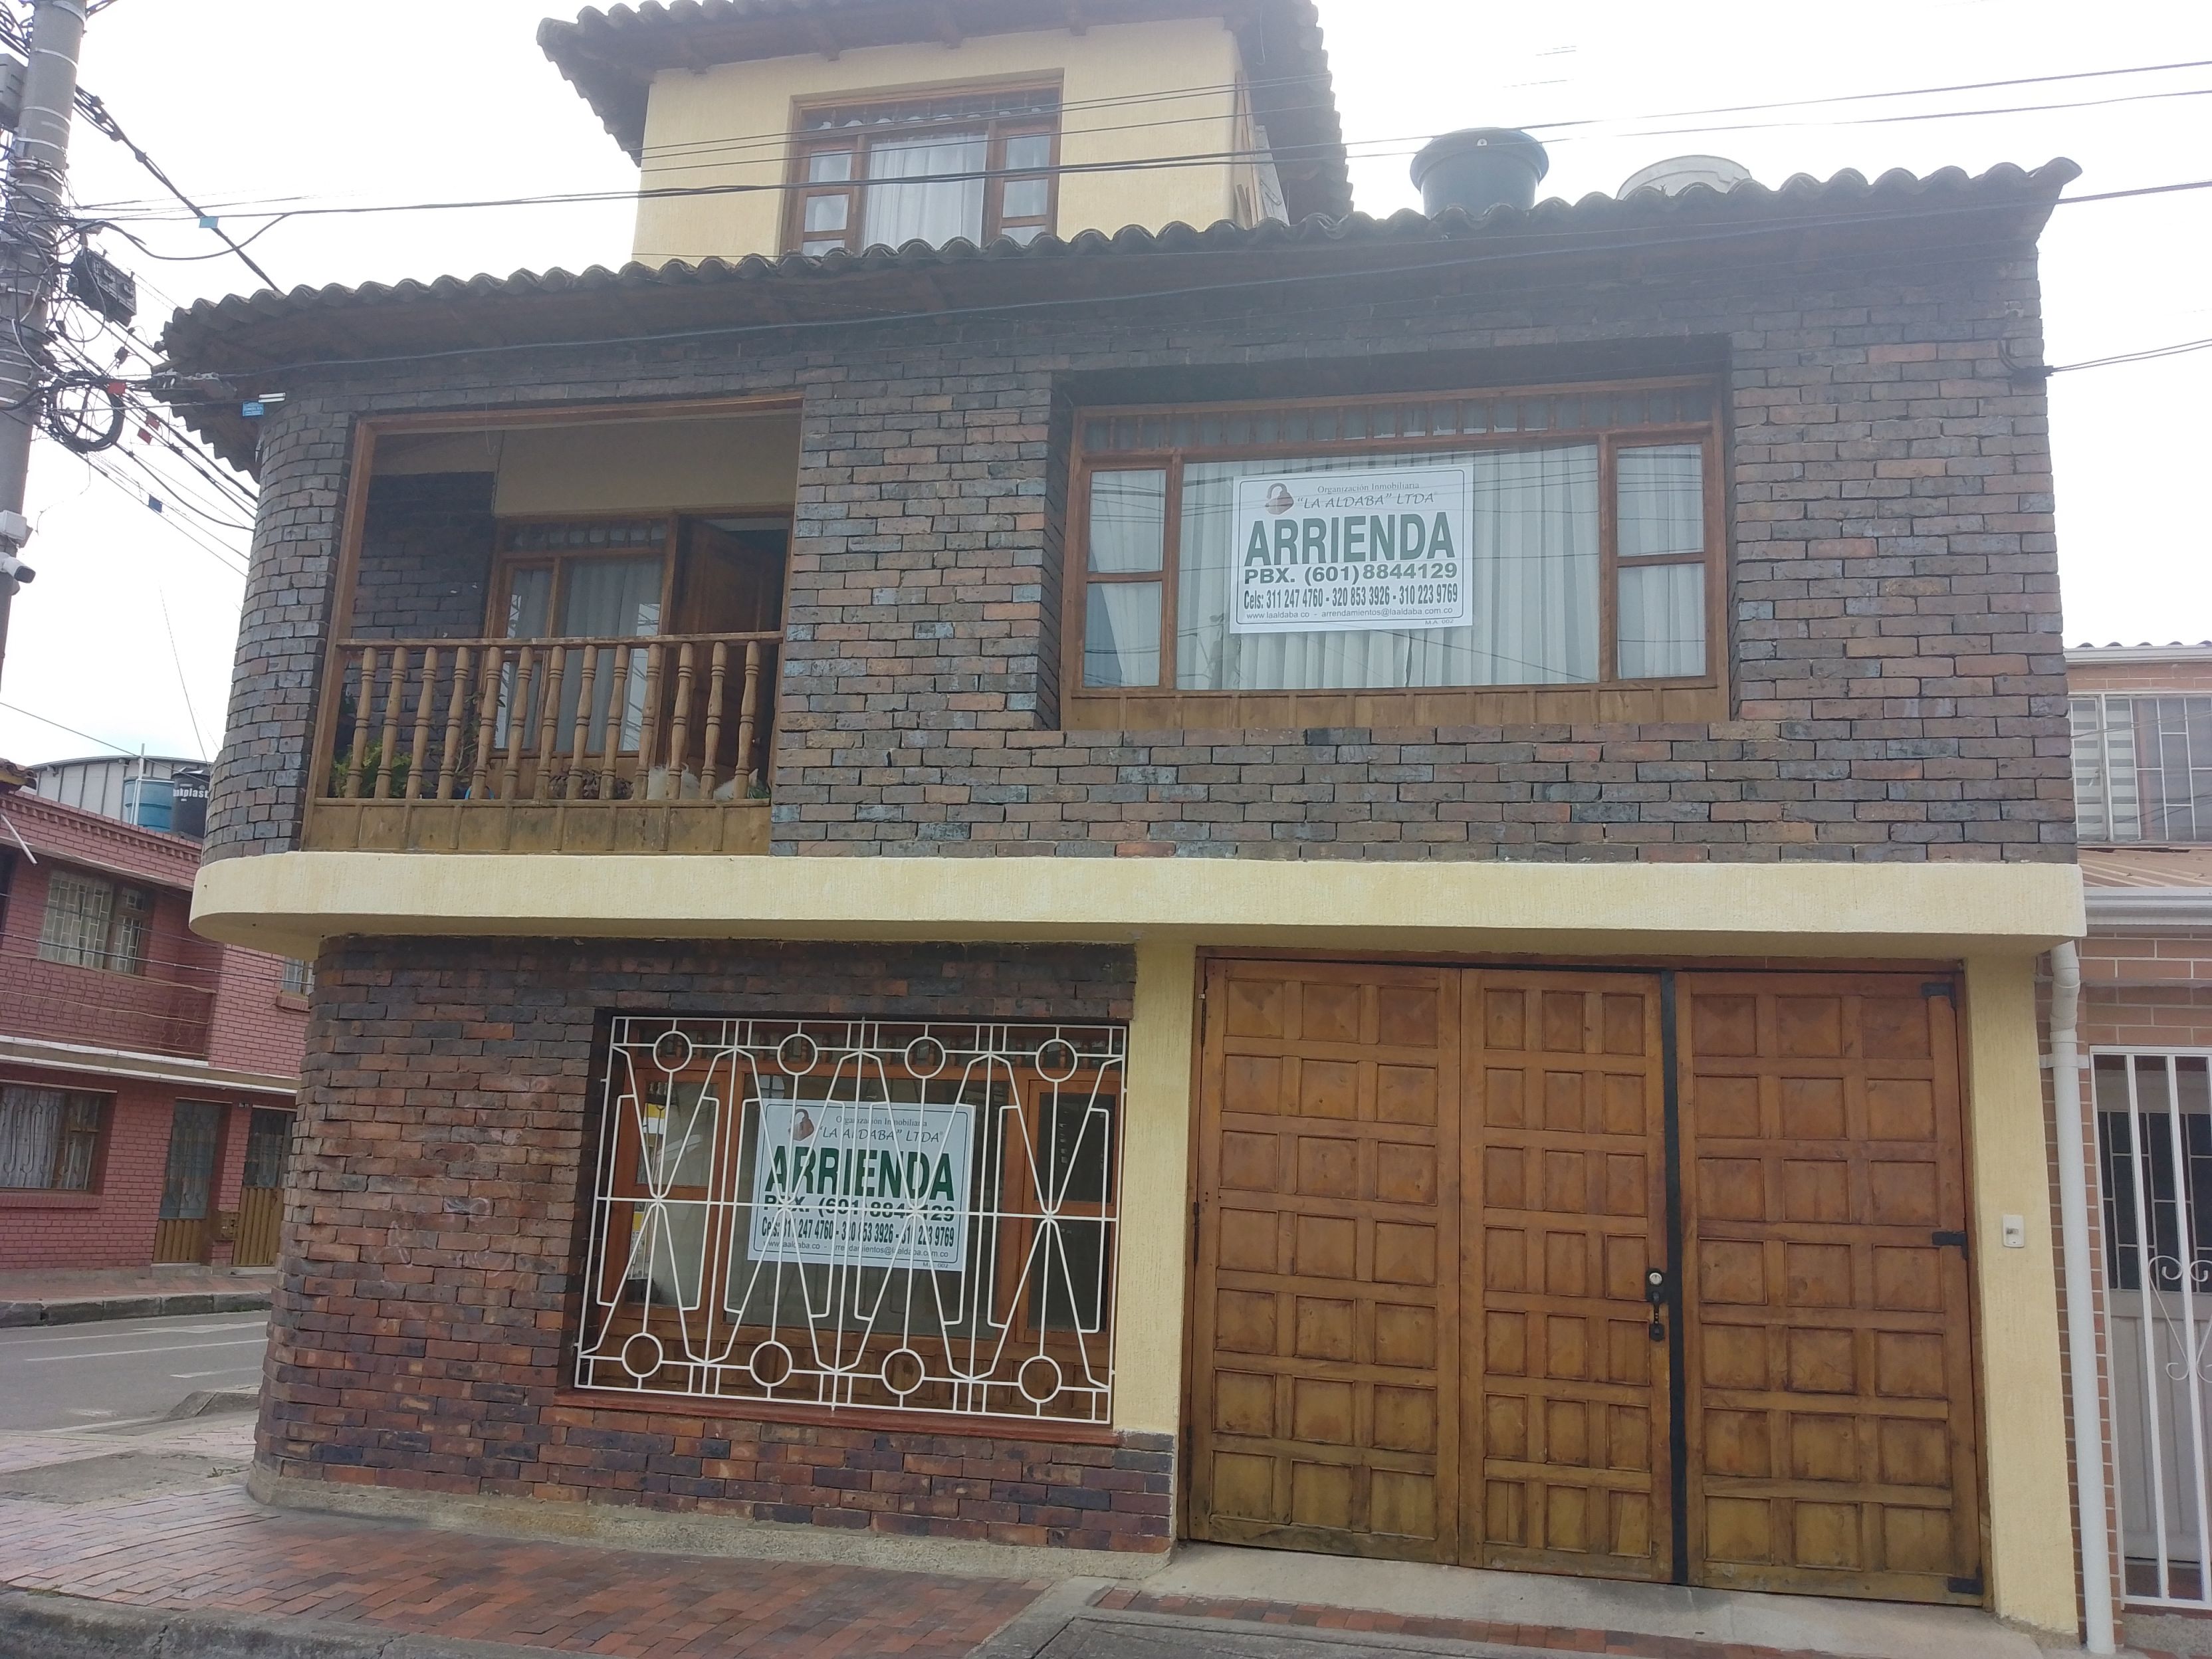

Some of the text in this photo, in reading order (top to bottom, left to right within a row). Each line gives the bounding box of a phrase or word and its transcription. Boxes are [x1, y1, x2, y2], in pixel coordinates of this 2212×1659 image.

[1317, 482, 1420, 495] Organización Inmobiliaria
[1396, 493, 1434, 504] LTDA
[1244, 511, 1456, 567] ARRIENDA
[1244, 567, 1296, 585] PBX.
[1244, 590, 1264, 609] Cels:
[1266, 589, 1281, 609] 311
[1284, 588, 1300, 608] 247
[1302, 588, 1323, 608] 4760
[1332, 587, 1348, 607] 320
[1350, 586, 1367, 606] 853
[1369, 586, 1390, 606] 3926
[1399, 585, 1415, 605] 310
[1418, 584, 1434, 604] 223
[1436, 583, 1458, 604] 9769
[906, 1130, 939, 1143] LTDA
[765, 1145, 954, 1202] ARRIENDA
[764, 1194, 810, 1212] PX.
[798, 1218, 813, 1238] 247
[814, 1219, 834, 1240] 4760
[841, 1220, 856, 1242] 30
[874, 1222, 894, 1244] 3926
[935, 1226, 954, 1247] 9769
